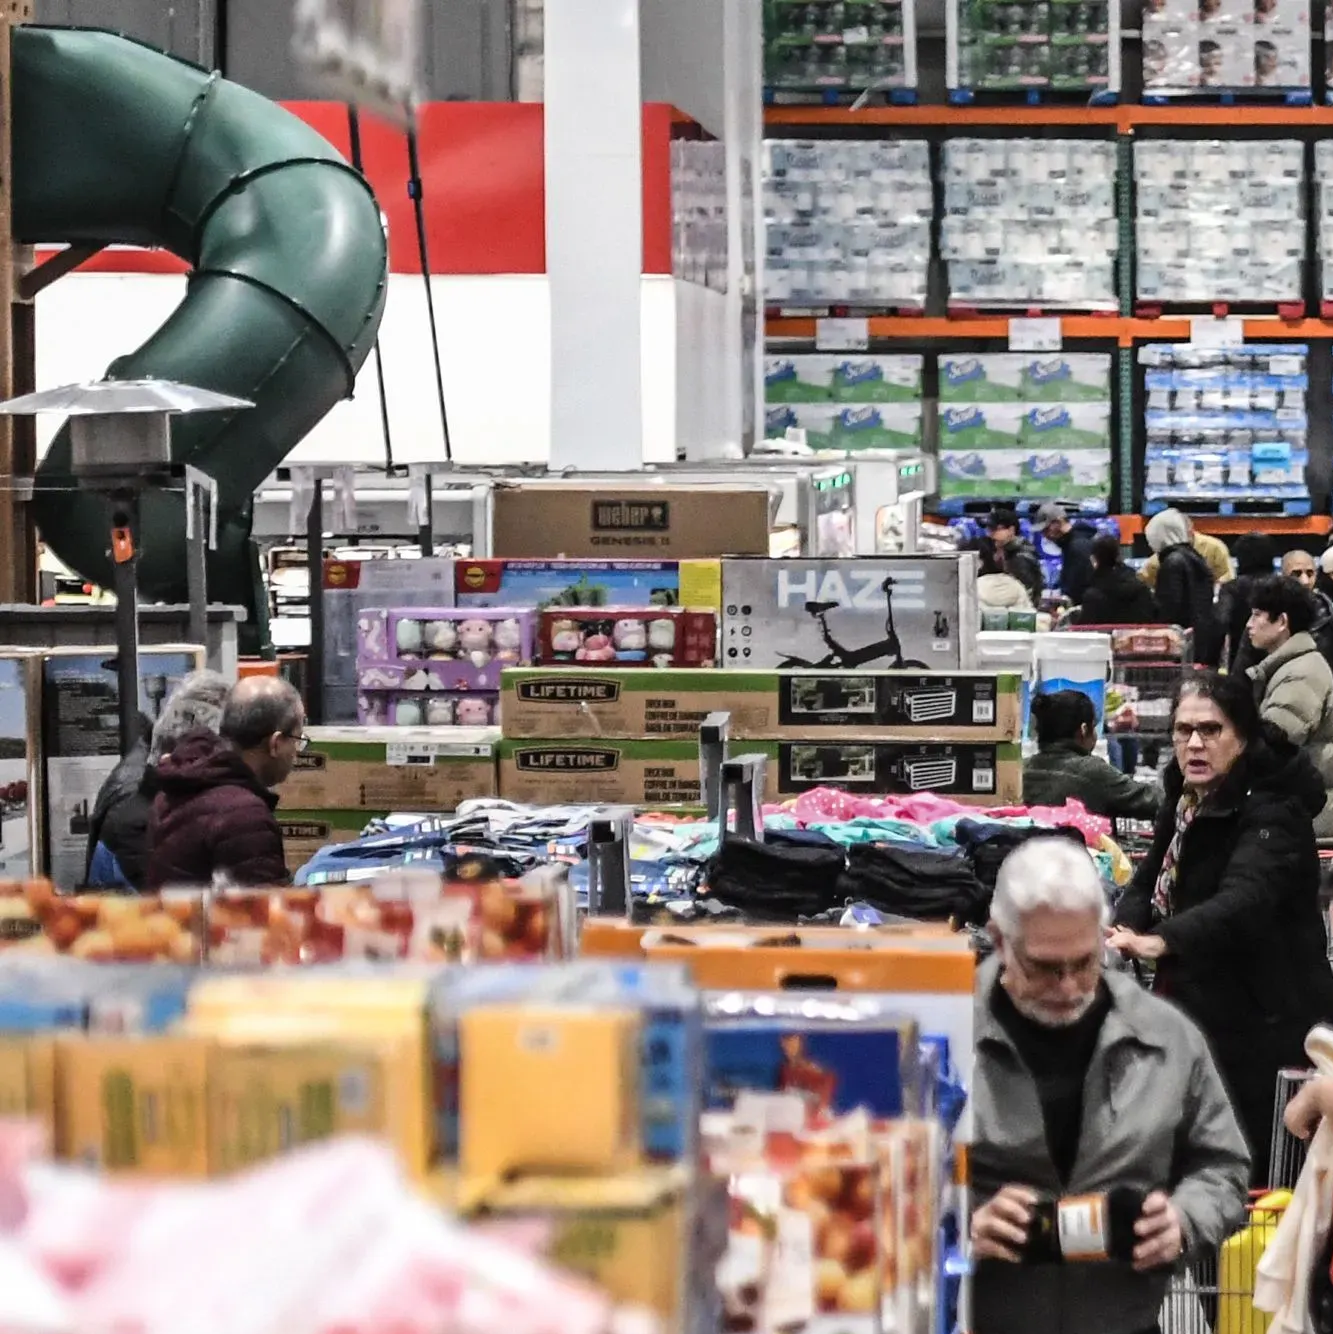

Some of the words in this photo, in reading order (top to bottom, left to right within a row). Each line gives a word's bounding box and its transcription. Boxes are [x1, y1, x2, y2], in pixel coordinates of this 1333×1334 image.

[598, 502, 648, 527] weber
[778, 569, 925, 609] HAZE
[530, 685, 608, 698] LIFETIME
[529, 753, 607, 766] LIFETIME
